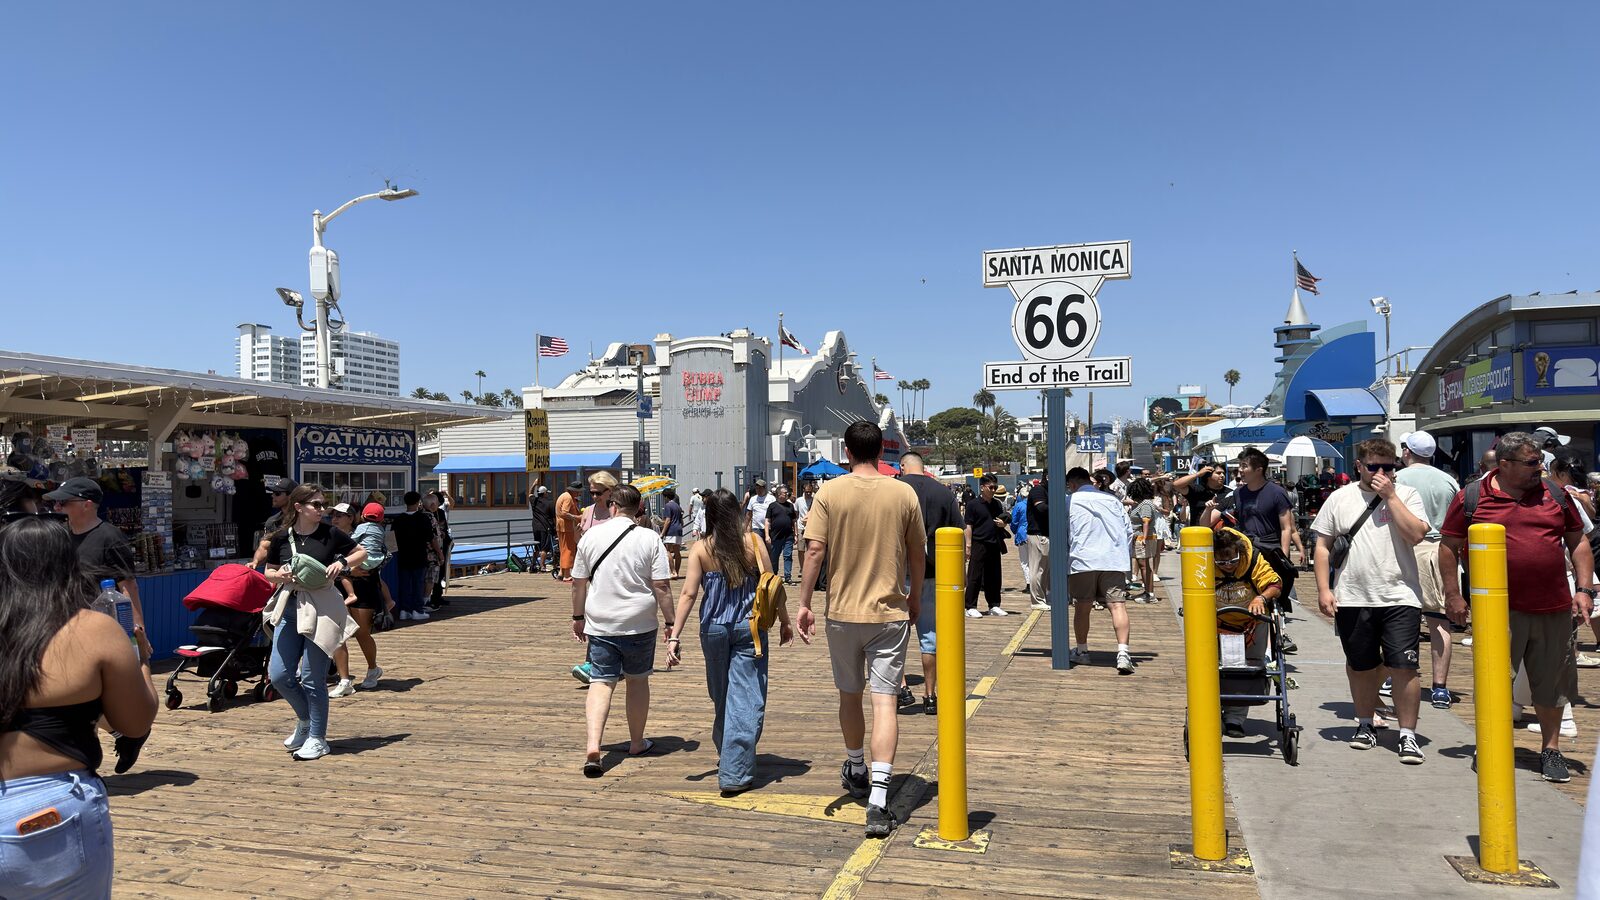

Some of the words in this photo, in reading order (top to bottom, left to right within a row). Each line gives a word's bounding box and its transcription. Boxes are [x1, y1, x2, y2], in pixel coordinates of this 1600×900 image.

[989, 254, 1044, 277] SANTA
[1051, 248, 1124, 273] MONICA
[1025, 294, 1087, 349] 66
[682, 369, 724, 386] BUBBA
[991, 366, 1022, 384] End
[1029, 365, 1046, 383] of
[1053, 365, 1080, 382] the
[1086, 362, 1123, 381] Trail
[1554, 357, 1600, 388] 2
[1446, 380, 1464, 401] OFFICIAL
[1465, 373, 1487, 396] LICENSED
[1487, 366, 1511, 392] PRODUCT
[685, 387, 721, 402] GUMP
[526, 410, 547, 428] Repent!
[307, 430, 405, 448] OATMAN
[528, 432, 549, 450] Believe
[1239, 429, 1265, 438] POLICE
[314, 446, 359, 457] ROCK
[364, 448, 404, 458] SHOP
[534, 454, 550, 469] Jesus
[1177, 458, 1191, 470] BA
